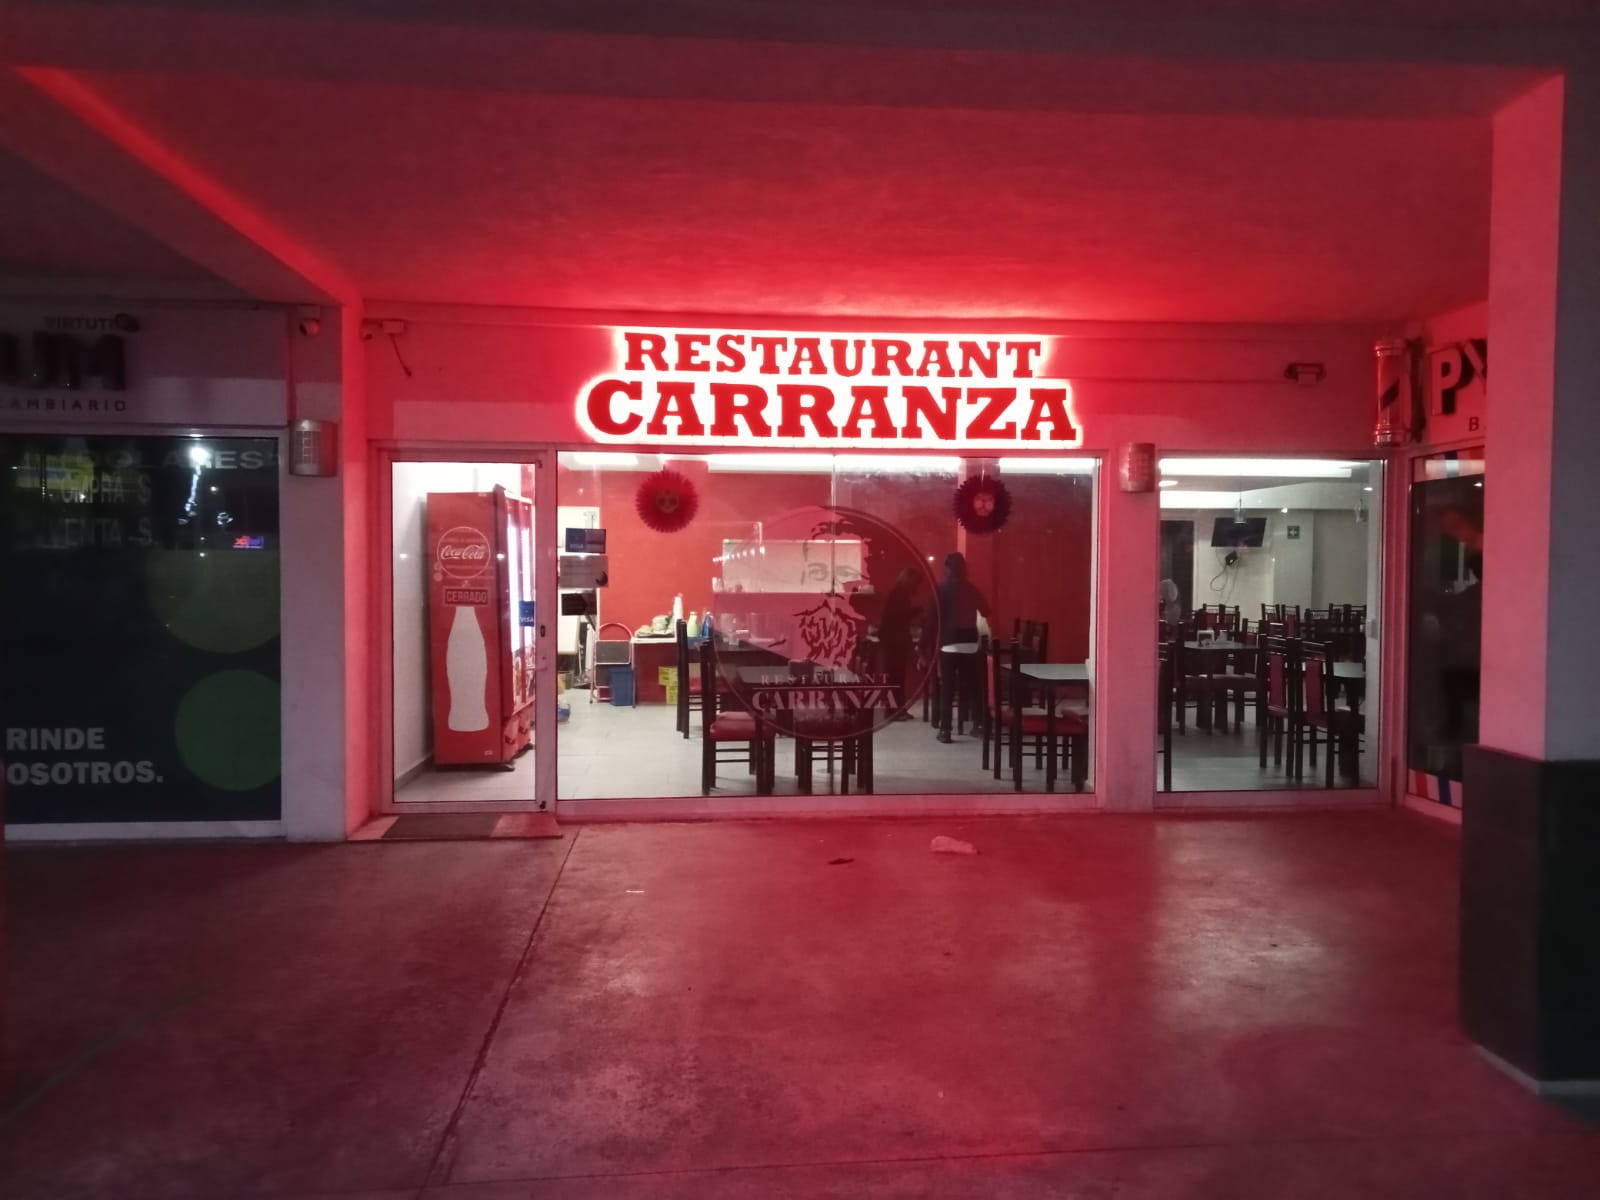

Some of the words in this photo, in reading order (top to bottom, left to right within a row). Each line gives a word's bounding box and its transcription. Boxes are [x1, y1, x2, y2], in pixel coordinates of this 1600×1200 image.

[623, 331, 1042, 379] RESTAURANT
[0, 397, 127, 412] AMBIARIO
[586, 378, 1077, 441] CARRANZA
[440, 543, 486, 561] Coca-Cola
[446, 590, 488, 603] CERRADO
[751, 689, 899, 711] CARRANZA
[5, 727, 105, 751] RINDE
[6, 760, 165, 786] OSOTROS.
